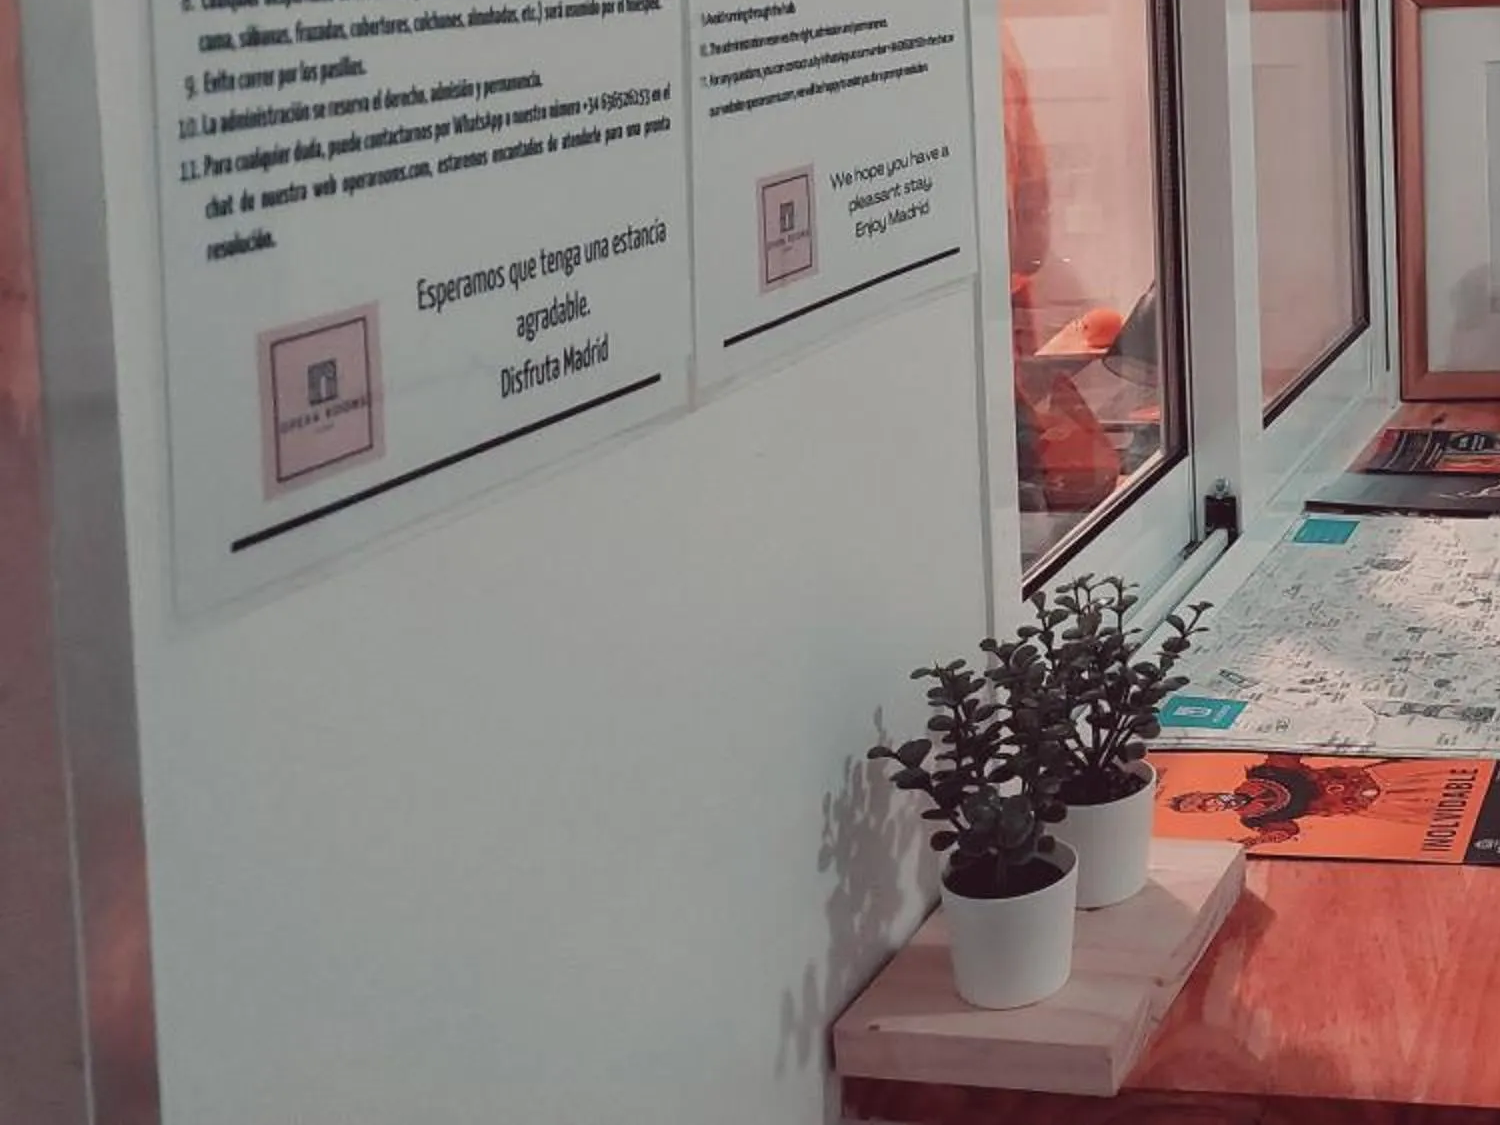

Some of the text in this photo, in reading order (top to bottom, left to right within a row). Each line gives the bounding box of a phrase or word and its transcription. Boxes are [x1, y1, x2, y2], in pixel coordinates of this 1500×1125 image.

[829, 145, 950, 191] We hope you have a
[847, 182, 902, 214] pleasant
[855, 198, 930, 239] Enjoy Madrid
[416, 218, 667, 314] Esperamos que tenga una estancia
[516, 290, 591, 342] agradable.
[500, 333, 609, 399] Disfruta Madrid
[1421, 768, 1479, 852] INOLVIDABLE
